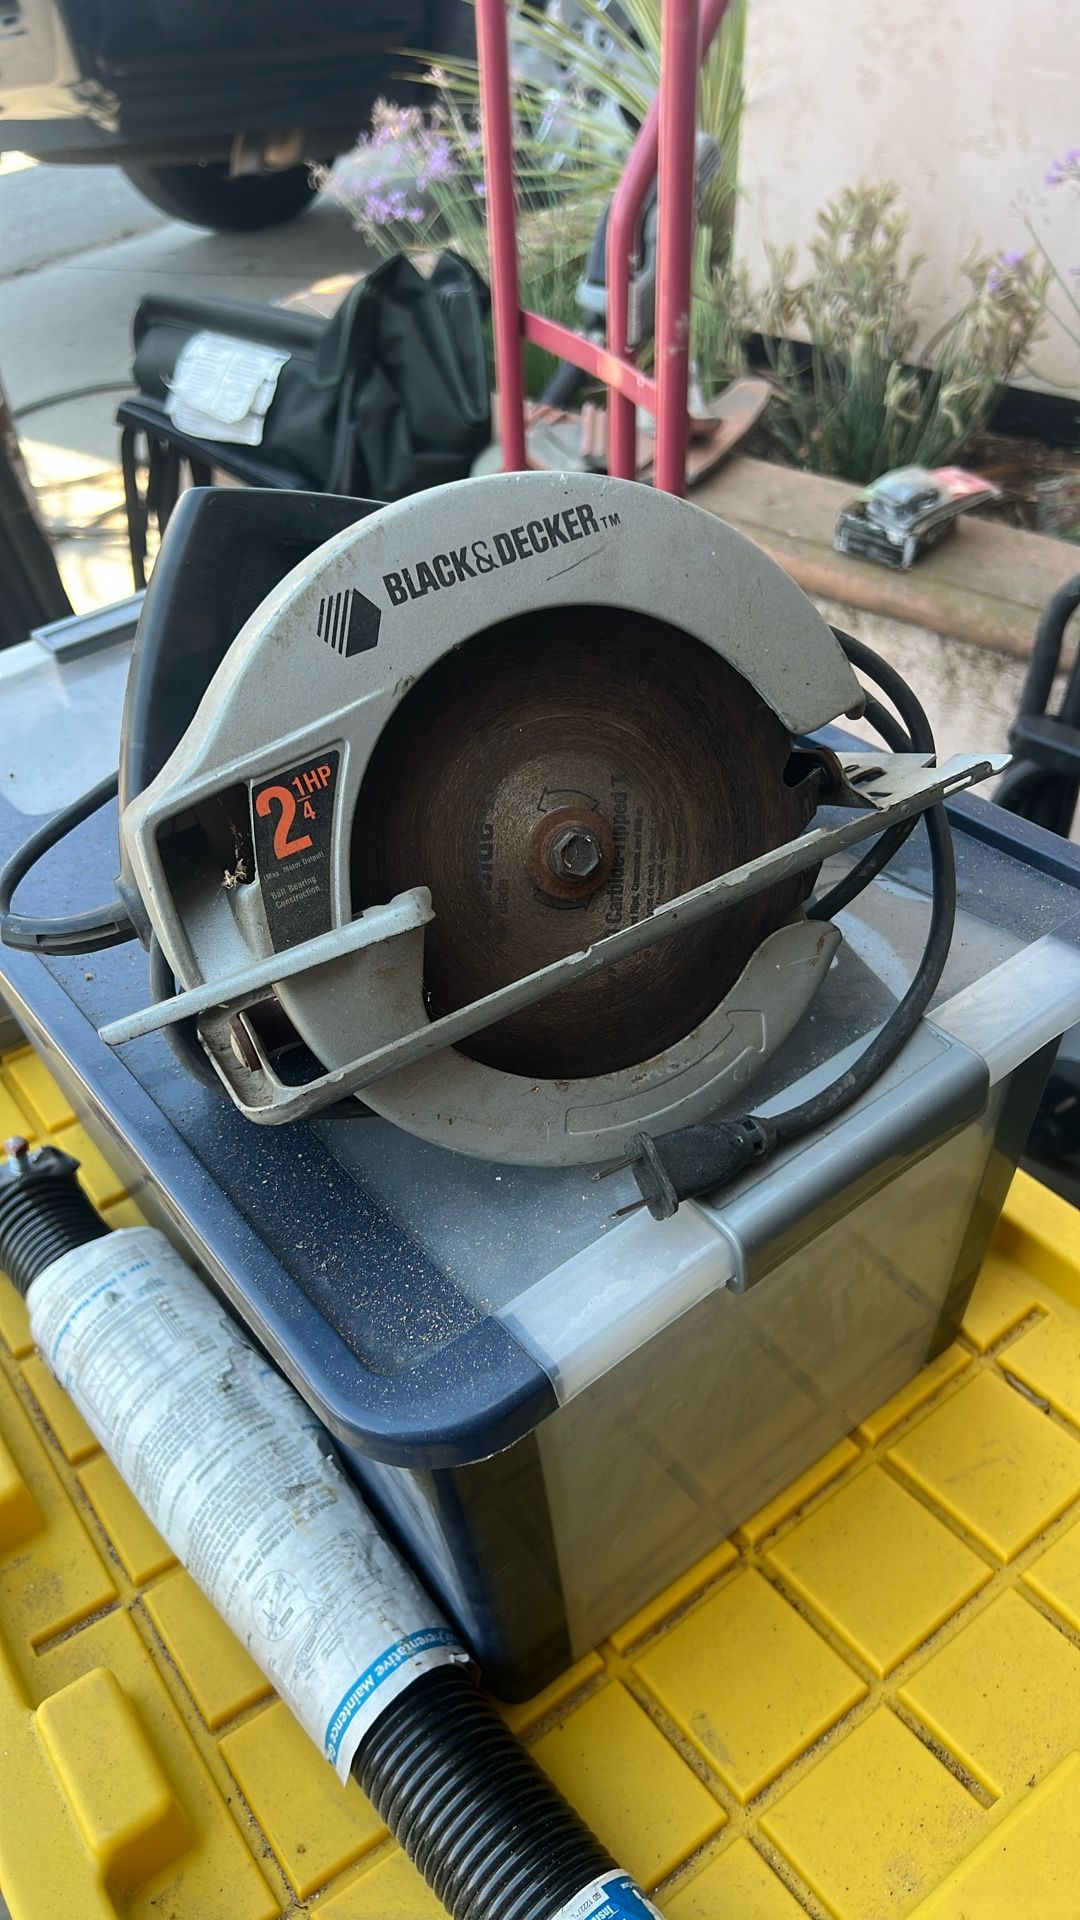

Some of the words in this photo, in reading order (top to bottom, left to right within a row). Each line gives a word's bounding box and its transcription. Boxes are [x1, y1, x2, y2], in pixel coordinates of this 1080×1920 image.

[383, 503, 600, 606] BLACK&DECKER
[256, 785, 313, 860] 2
[287, 876, 317, 892] Bearing
[329, 1674, 376, 1742] Maintence
